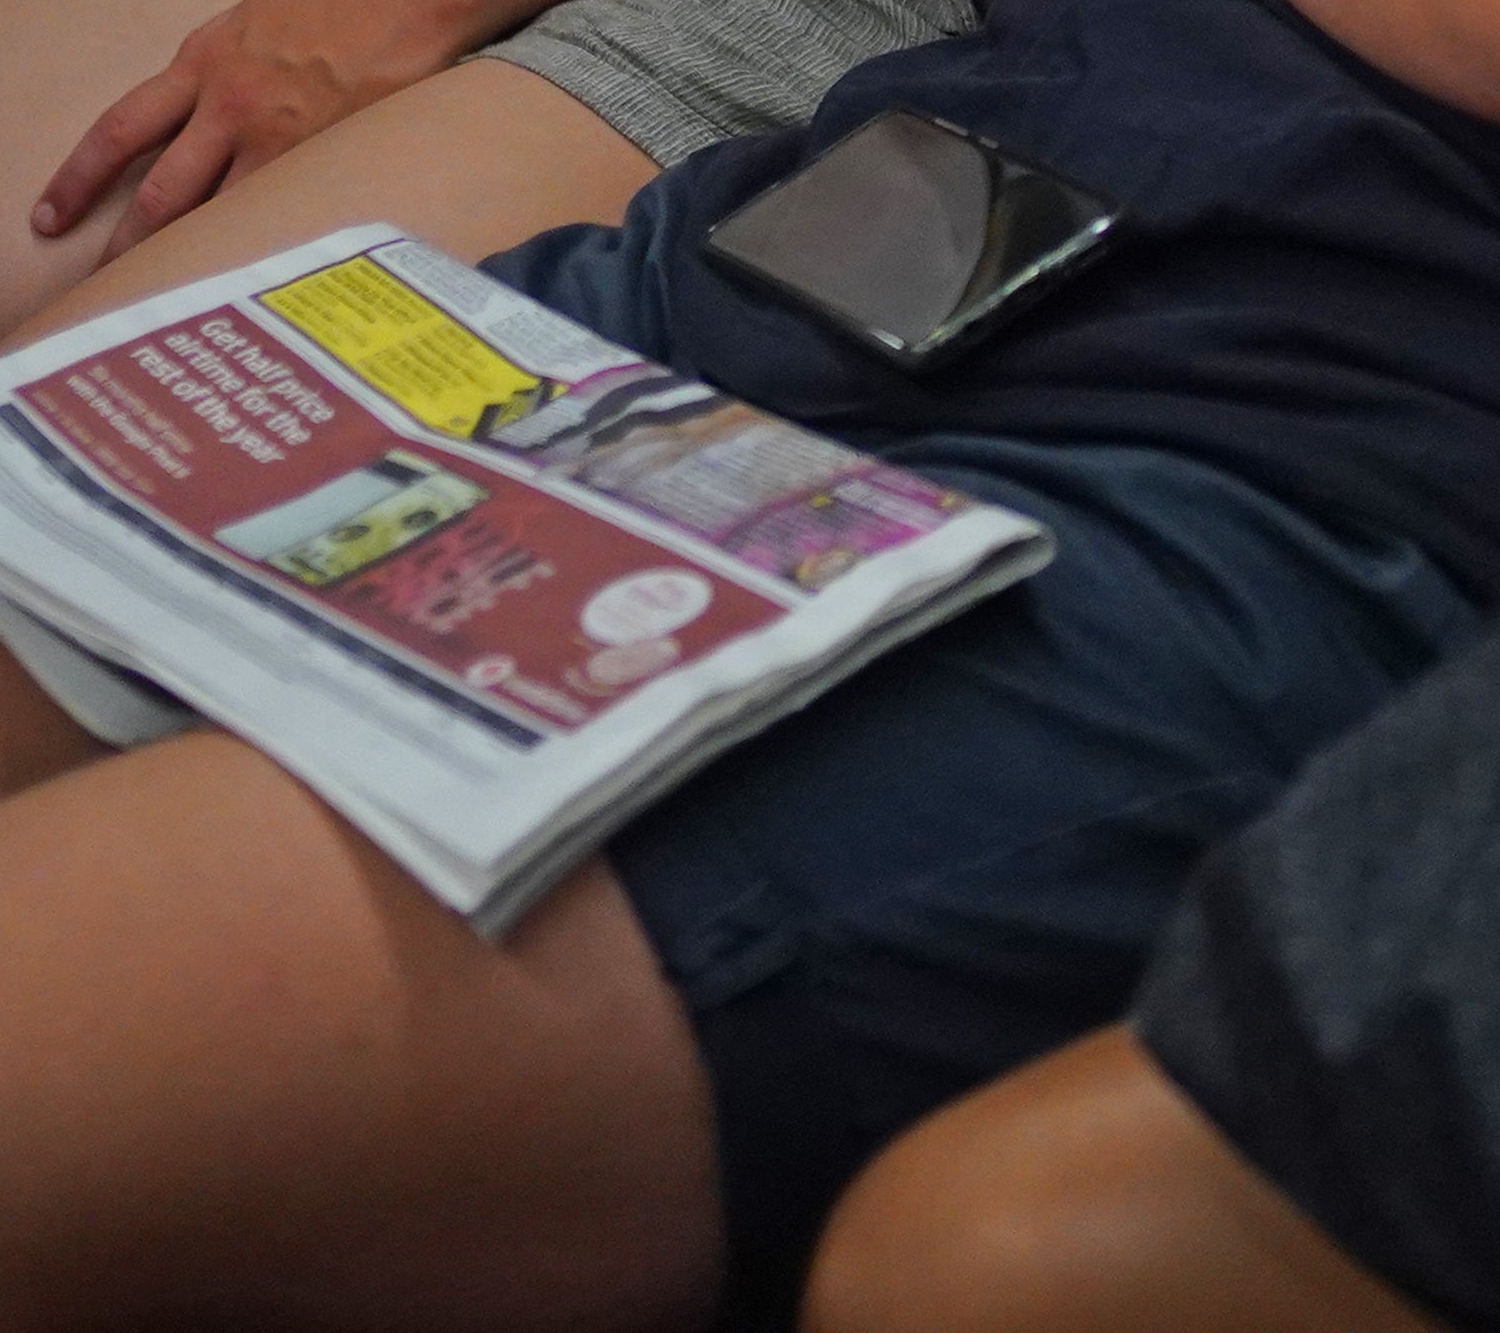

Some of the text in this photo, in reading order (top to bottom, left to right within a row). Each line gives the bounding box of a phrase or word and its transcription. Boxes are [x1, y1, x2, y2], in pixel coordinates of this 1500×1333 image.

[131, 346, 287, 464] rest of the year
[165, 332, 312, 446] airtime for the
[200, 318, 334, 424] Get half price
